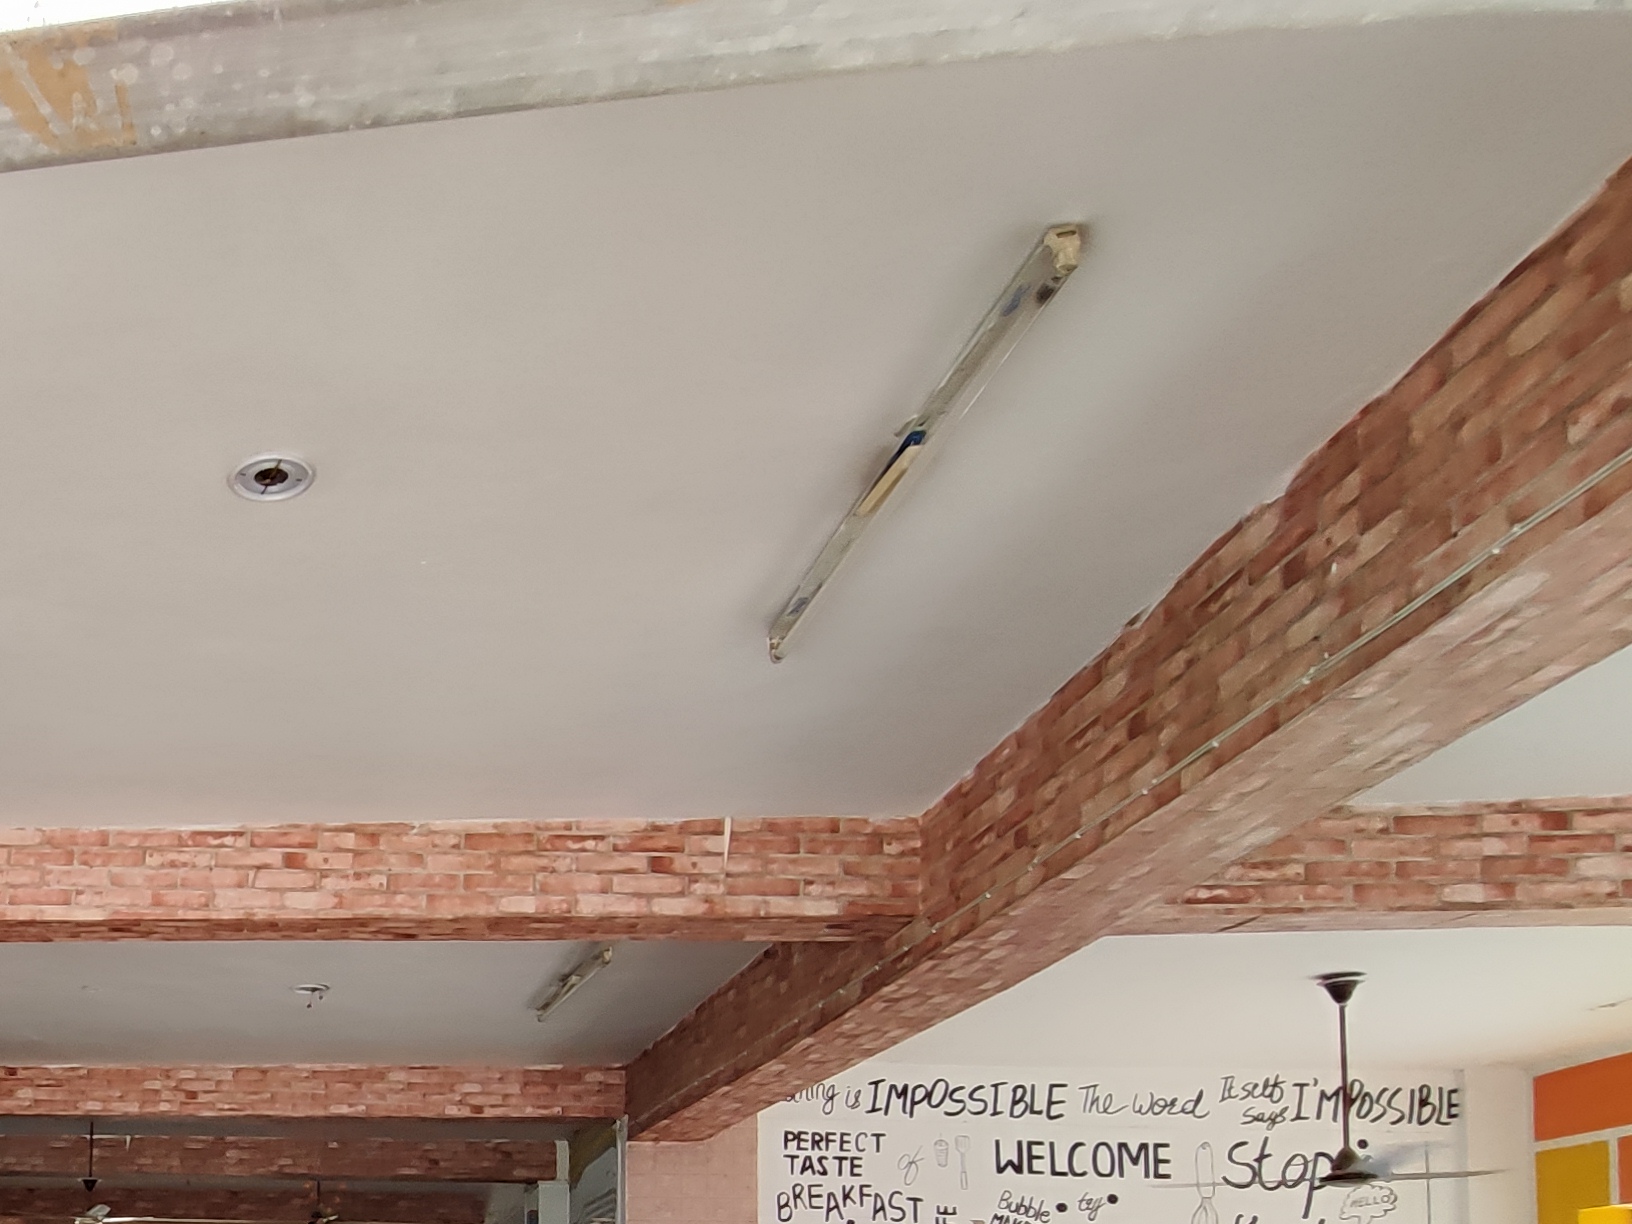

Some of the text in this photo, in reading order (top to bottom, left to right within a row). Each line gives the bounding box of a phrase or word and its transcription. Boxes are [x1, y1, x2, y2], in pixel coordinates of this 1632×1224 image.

[845, 1086, 861, 1109] is
[865, 1078, 1068, 1120] IMPOSSIBLE
[1078, 1084, 1129, 1115] The
[783, 1130, 886, 1153] PERFECT
[995, 1138, 1172, 1180] WELCOME
[783, 1145, 924, 1185] TASTE of
[1222, 1136, 1336, 1219] Stop
[777, 1183, 924, 1223] BREAKFAST
[997, 1190, 1051, 1223] Bubble
